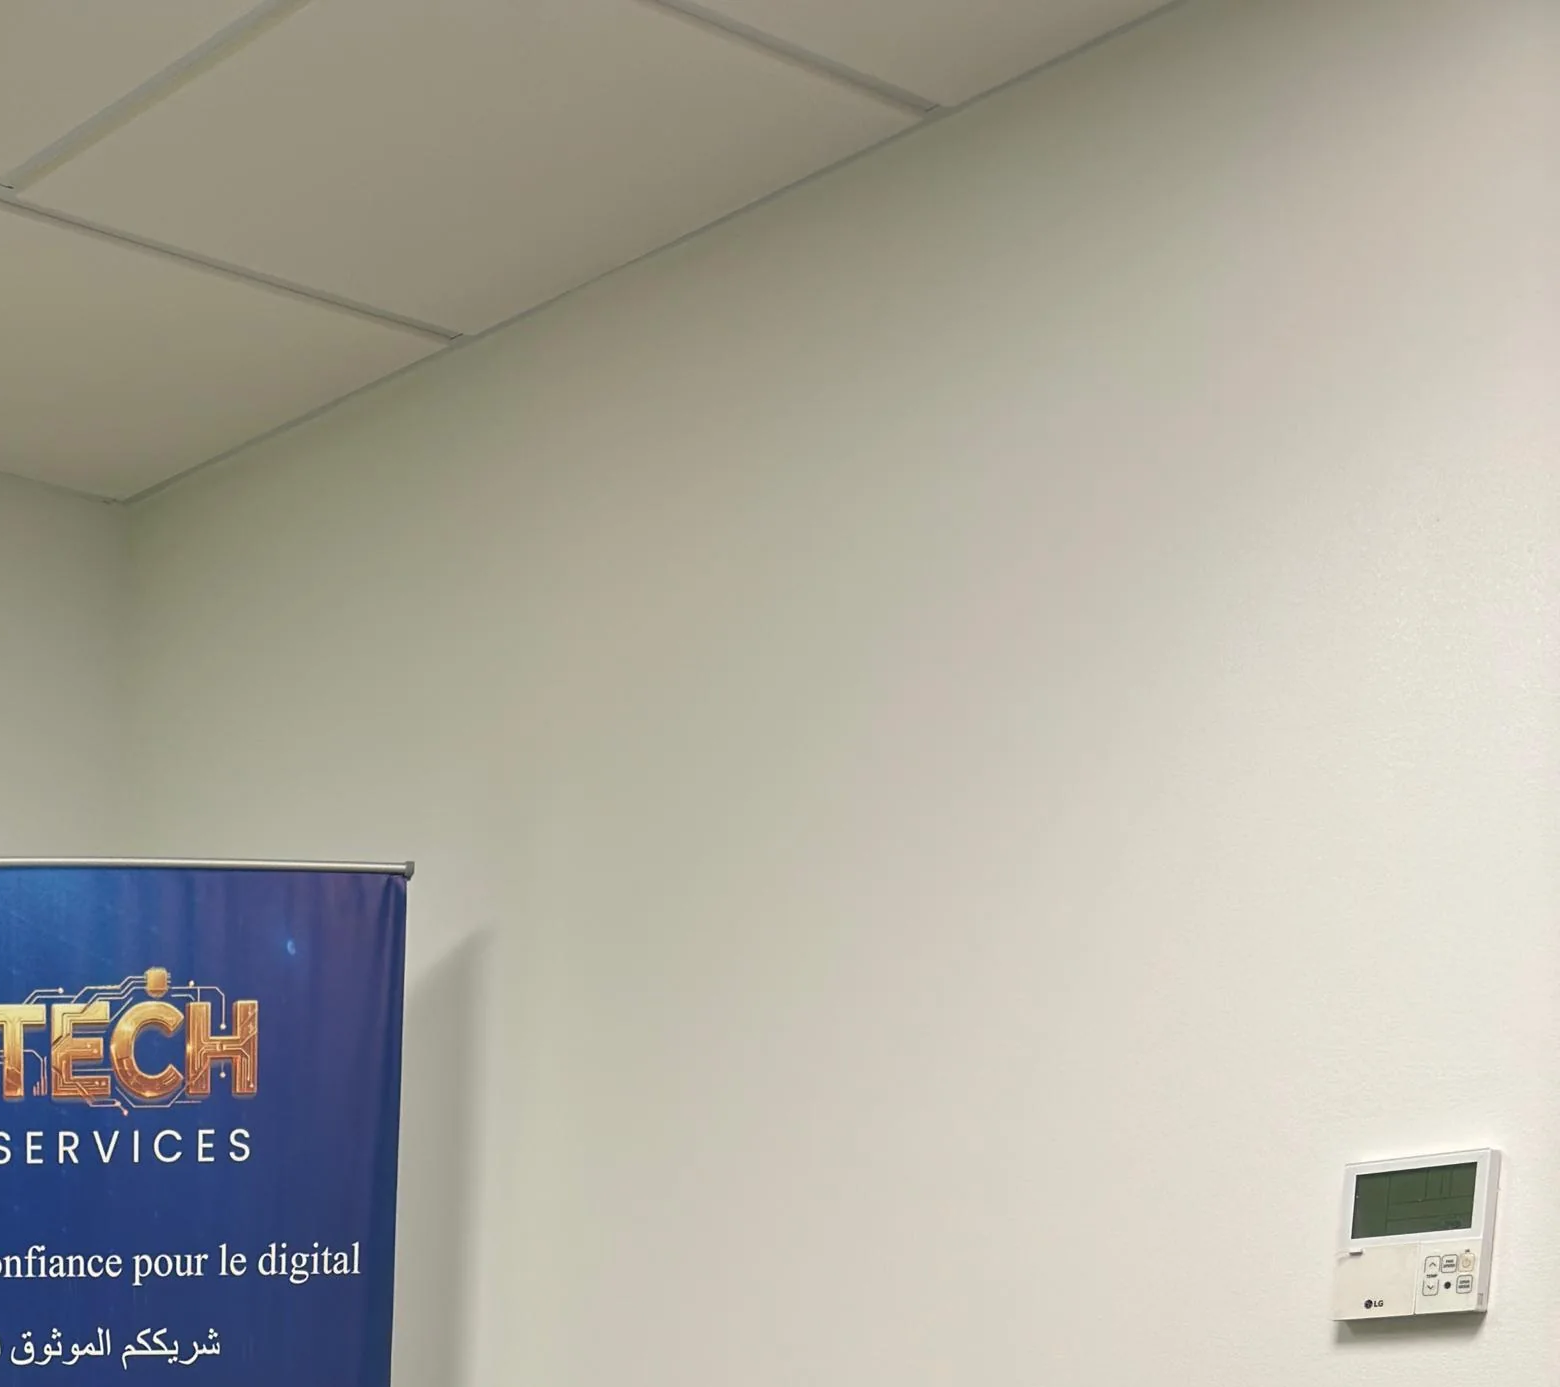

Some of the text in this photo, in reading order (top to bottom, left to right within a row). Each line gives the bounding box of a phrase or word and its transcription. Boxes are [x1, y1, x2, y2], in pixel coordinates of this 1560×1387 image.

[132, 1253, 209, 1286] pour
[219, 1243, 247, 1276] le
[258, 1241, 361, 1284] digital
[10, 1327, 111, 1366] الموثوق
[121, 1327, 221, 1370] شريككم
